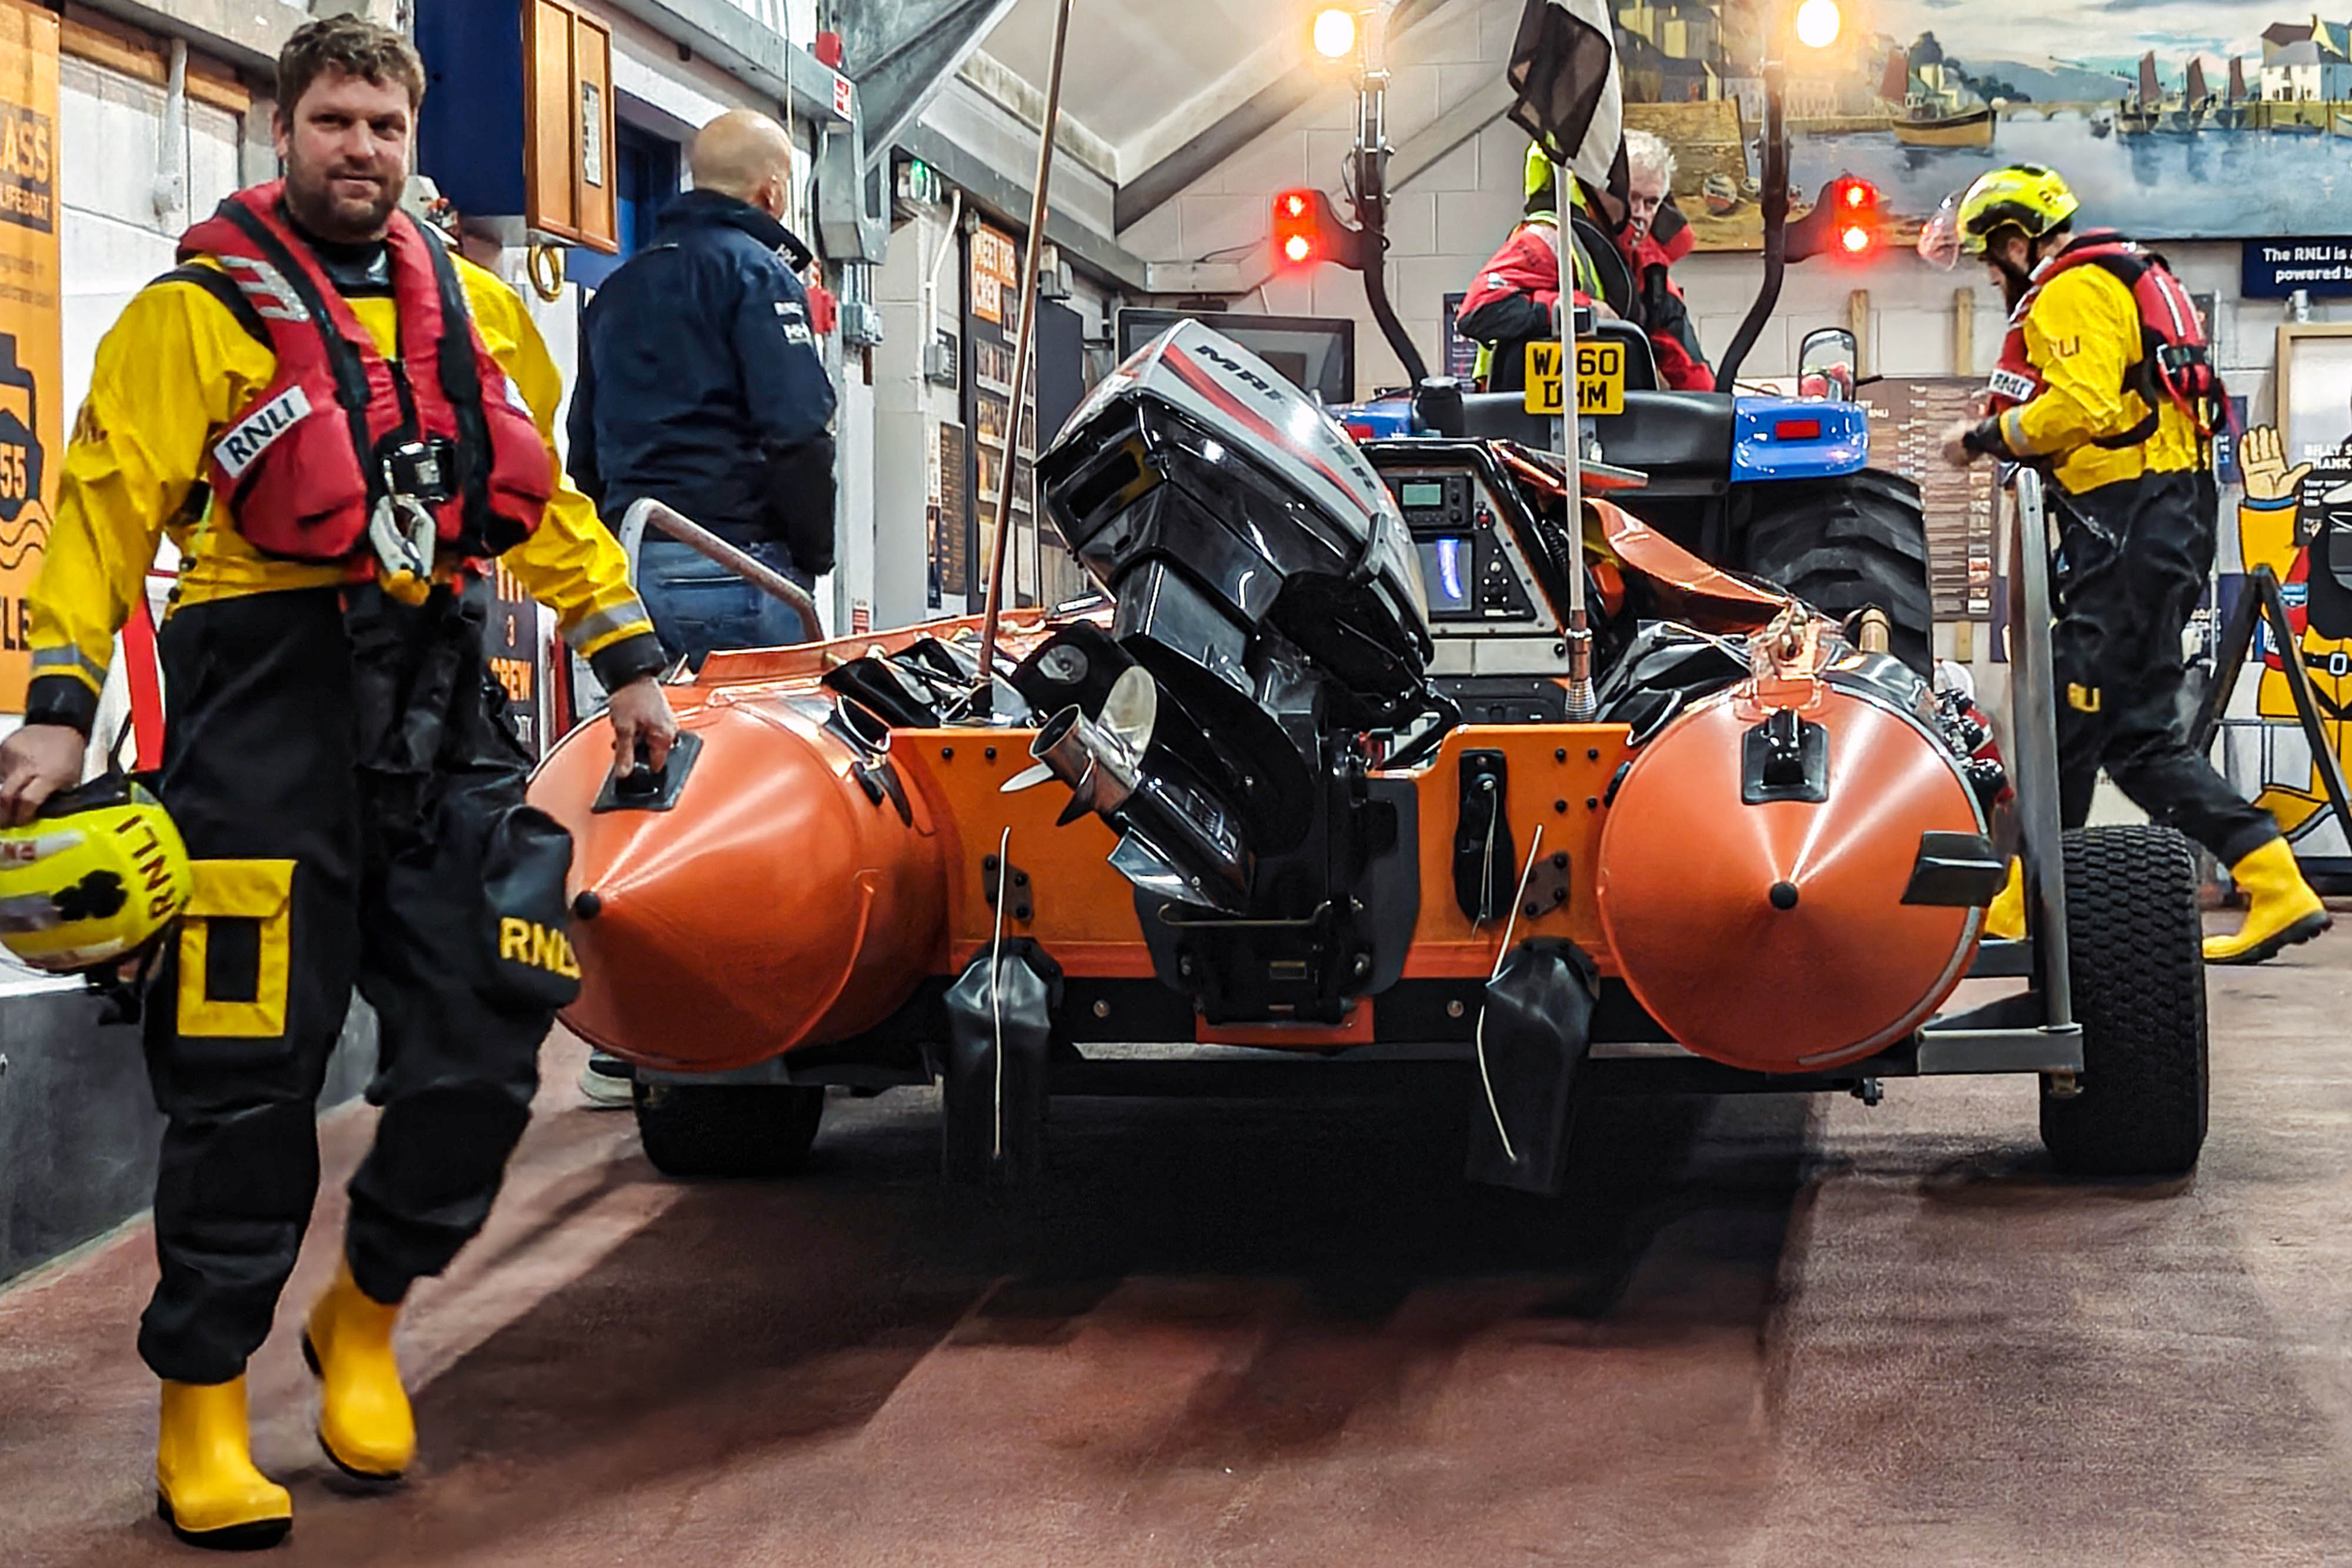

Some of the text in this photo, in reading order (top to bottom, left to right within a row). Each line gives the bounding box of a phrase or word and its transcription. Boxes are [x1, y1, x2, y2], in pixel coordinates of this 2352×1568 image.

[0, 116, 48, 183] ASS
[2262, 245, 2347, 262] The RNLI is
[2275, 265, 2341, 285] powered
[224, 398, 296, 466] RNLI
[114, 815, 175, 919] RNLI
